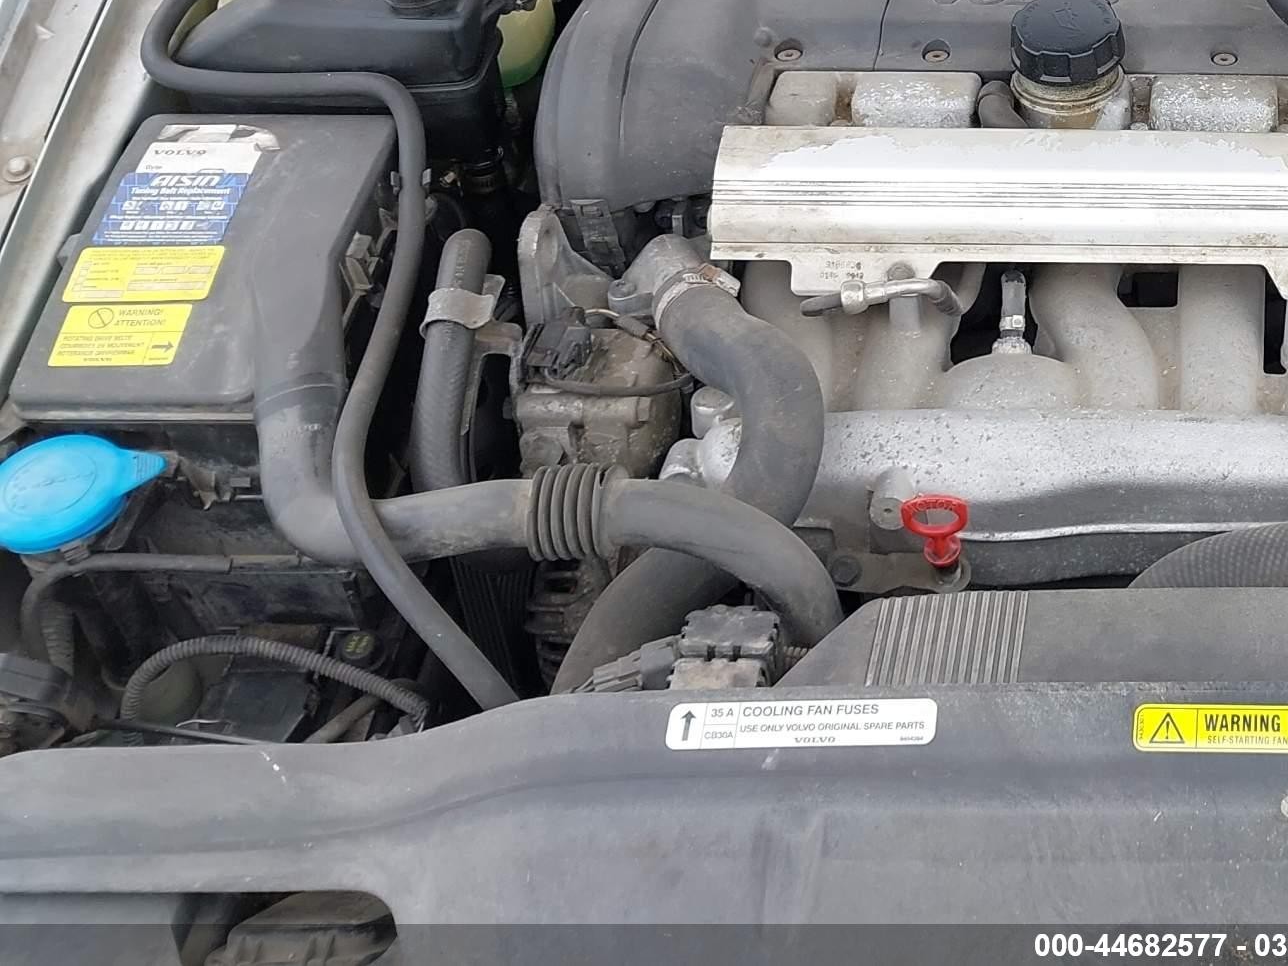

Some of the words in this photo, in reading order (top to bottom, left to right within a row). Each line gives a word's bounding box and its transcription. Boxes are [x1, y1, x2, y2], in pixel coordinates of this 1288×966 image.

[153, 148, 207, 156] VOLVO
[150, 175, 221, 187] AISIN
[114, 319, 166, 327] ATTENTION!
[711, 708, 723, 717] 35
[726, 708, 734, 717] A
[743, 705, 803, 717] COOLING
[807, 705, 832, 715] FAN
[836, 704, 879, 715] FUSES
[739, 724, 758, 733] USE
[760, 724, 784, 732] ONLY
[786, 723, 815, 731] VOLVO
[819, 723, 860, 731] ORIGINAL
[864, 722, 894, 730] SPARE
[895, 722, 925, 730] PARTS
[1205, 713, 1281, 732] WARNING
[1207, 736, 1270, 745] SELF-STARTING
[1272, 736, 1288, 745] FAN
